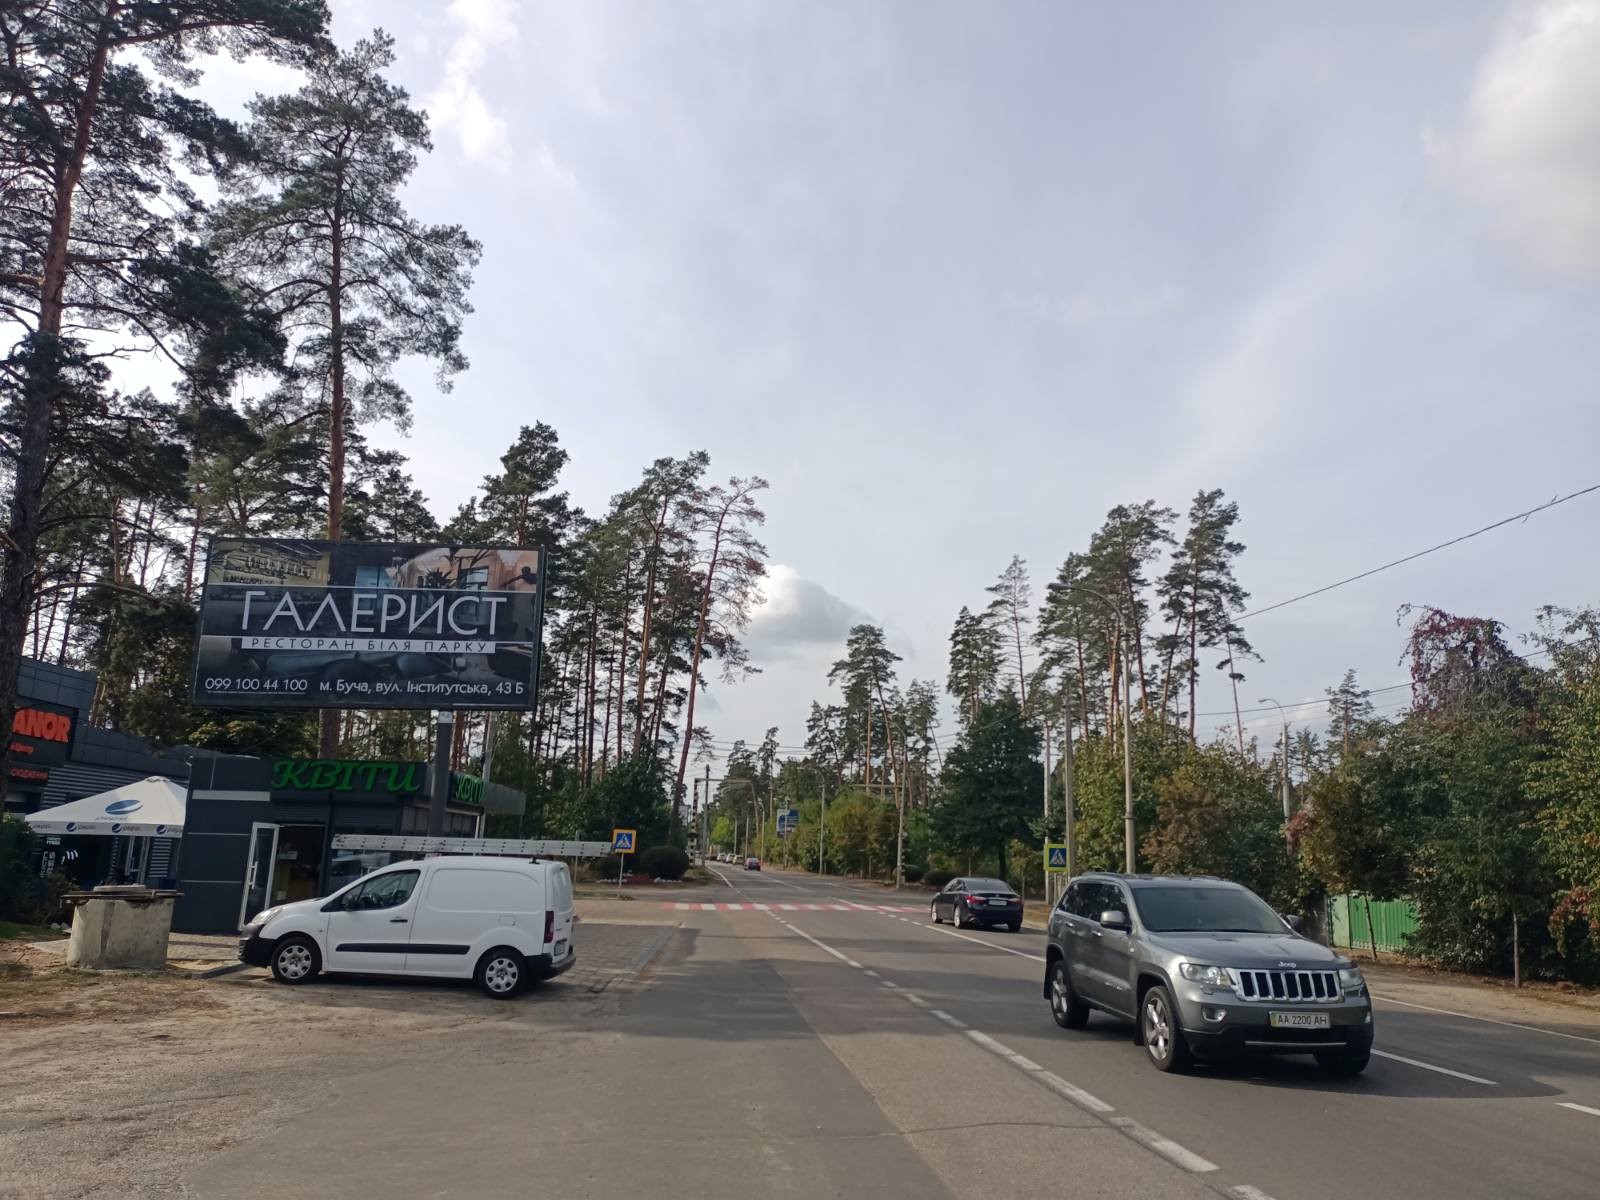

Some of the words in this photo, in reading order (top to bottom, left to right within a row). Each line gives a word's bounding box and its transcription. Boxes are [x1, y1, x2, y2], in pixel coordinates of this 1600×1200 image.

[242, 590, 507, 636] ГАЛЕРИСТ
[251, 638, 355, 650] РЕСТОРАН
[367, 639, 411, 651] БІЛЯ
[424, 641, 486, 653] ПАРКУ
[204, 677, 232, 690] 099
[236, 678, 260, 690] 100
[263, 679, 279, 691] 44
[283, 679, 308, 691] 100
[319, 681, 333, 691] м.
[336, 679, 372, 694] Буча,
[375, 682, 403, 695] вул.
[406, 681, 492, 696] Інститутська,
[495, 682, 513, 694] 43
[515, 682, 525, 694] Б
[1291, 1016, 1312, 1025] 2200
